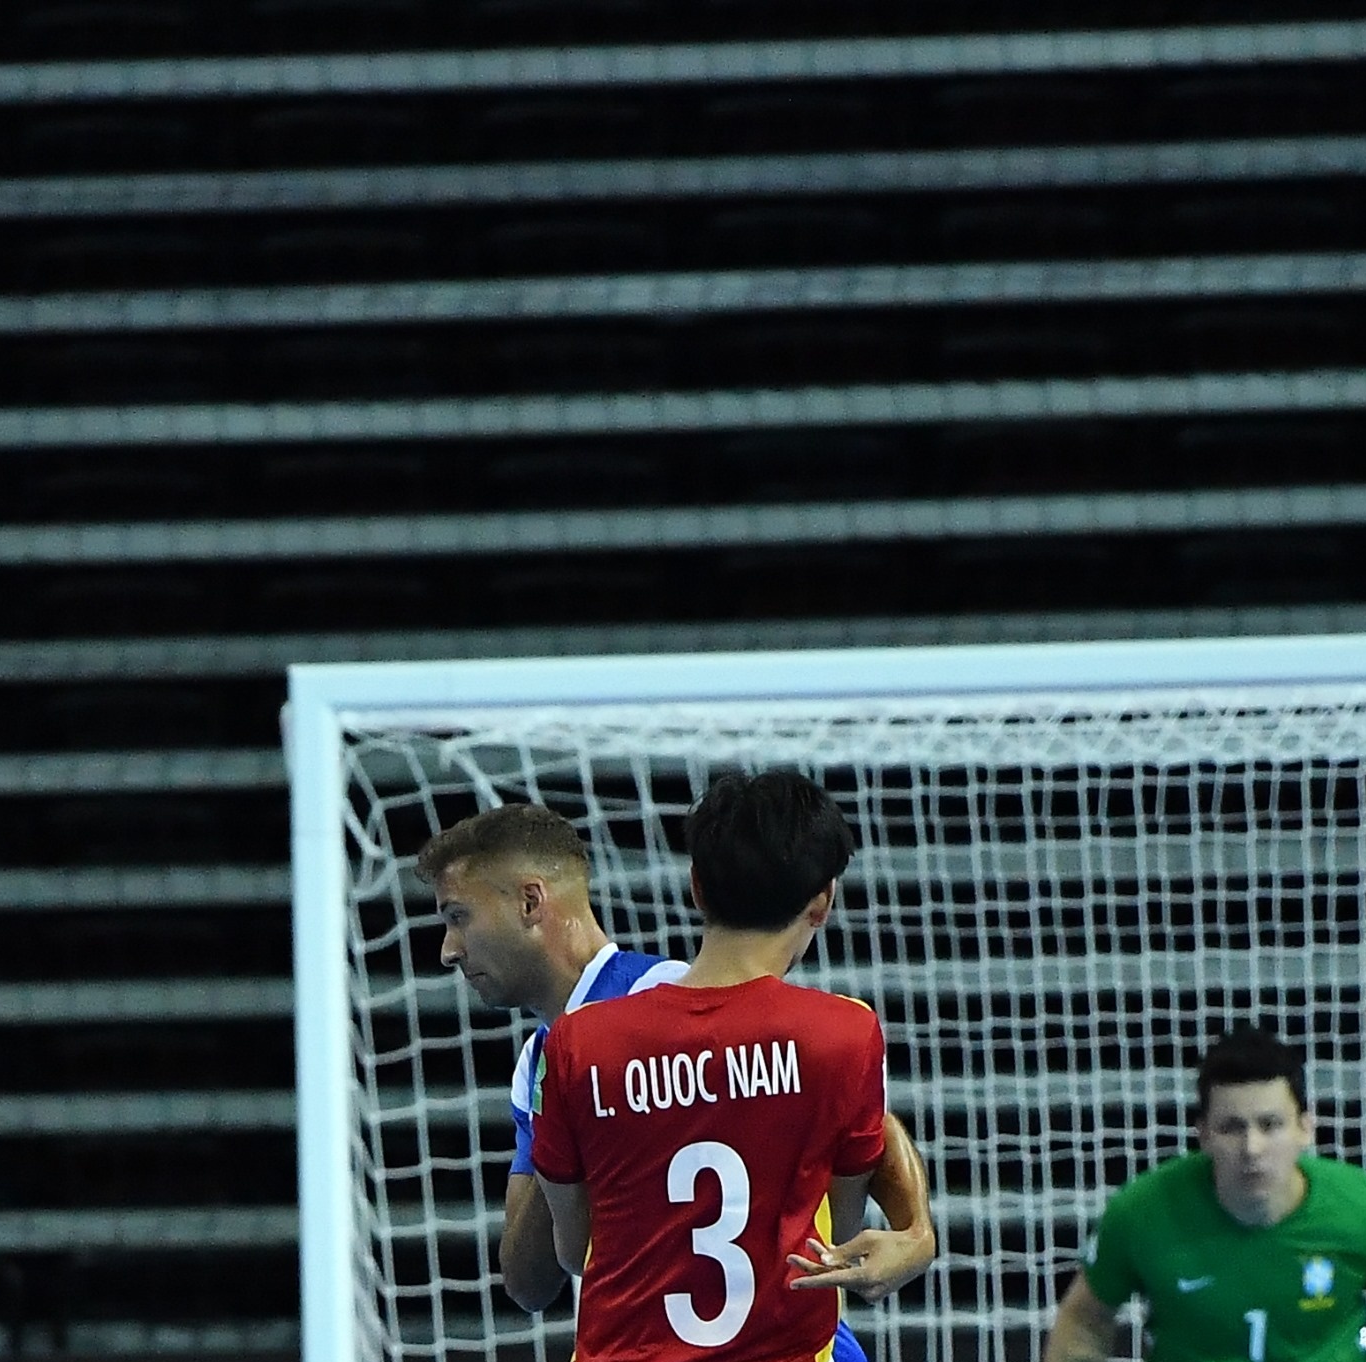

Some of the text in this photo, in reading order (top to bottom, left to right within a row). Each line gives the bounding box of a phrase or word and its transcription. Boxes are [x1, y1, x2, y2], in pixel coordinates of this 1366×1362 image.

[591, 1040, 801, 1118] L. QUOC NAM
[663, 1140, 756, 1347] 3
